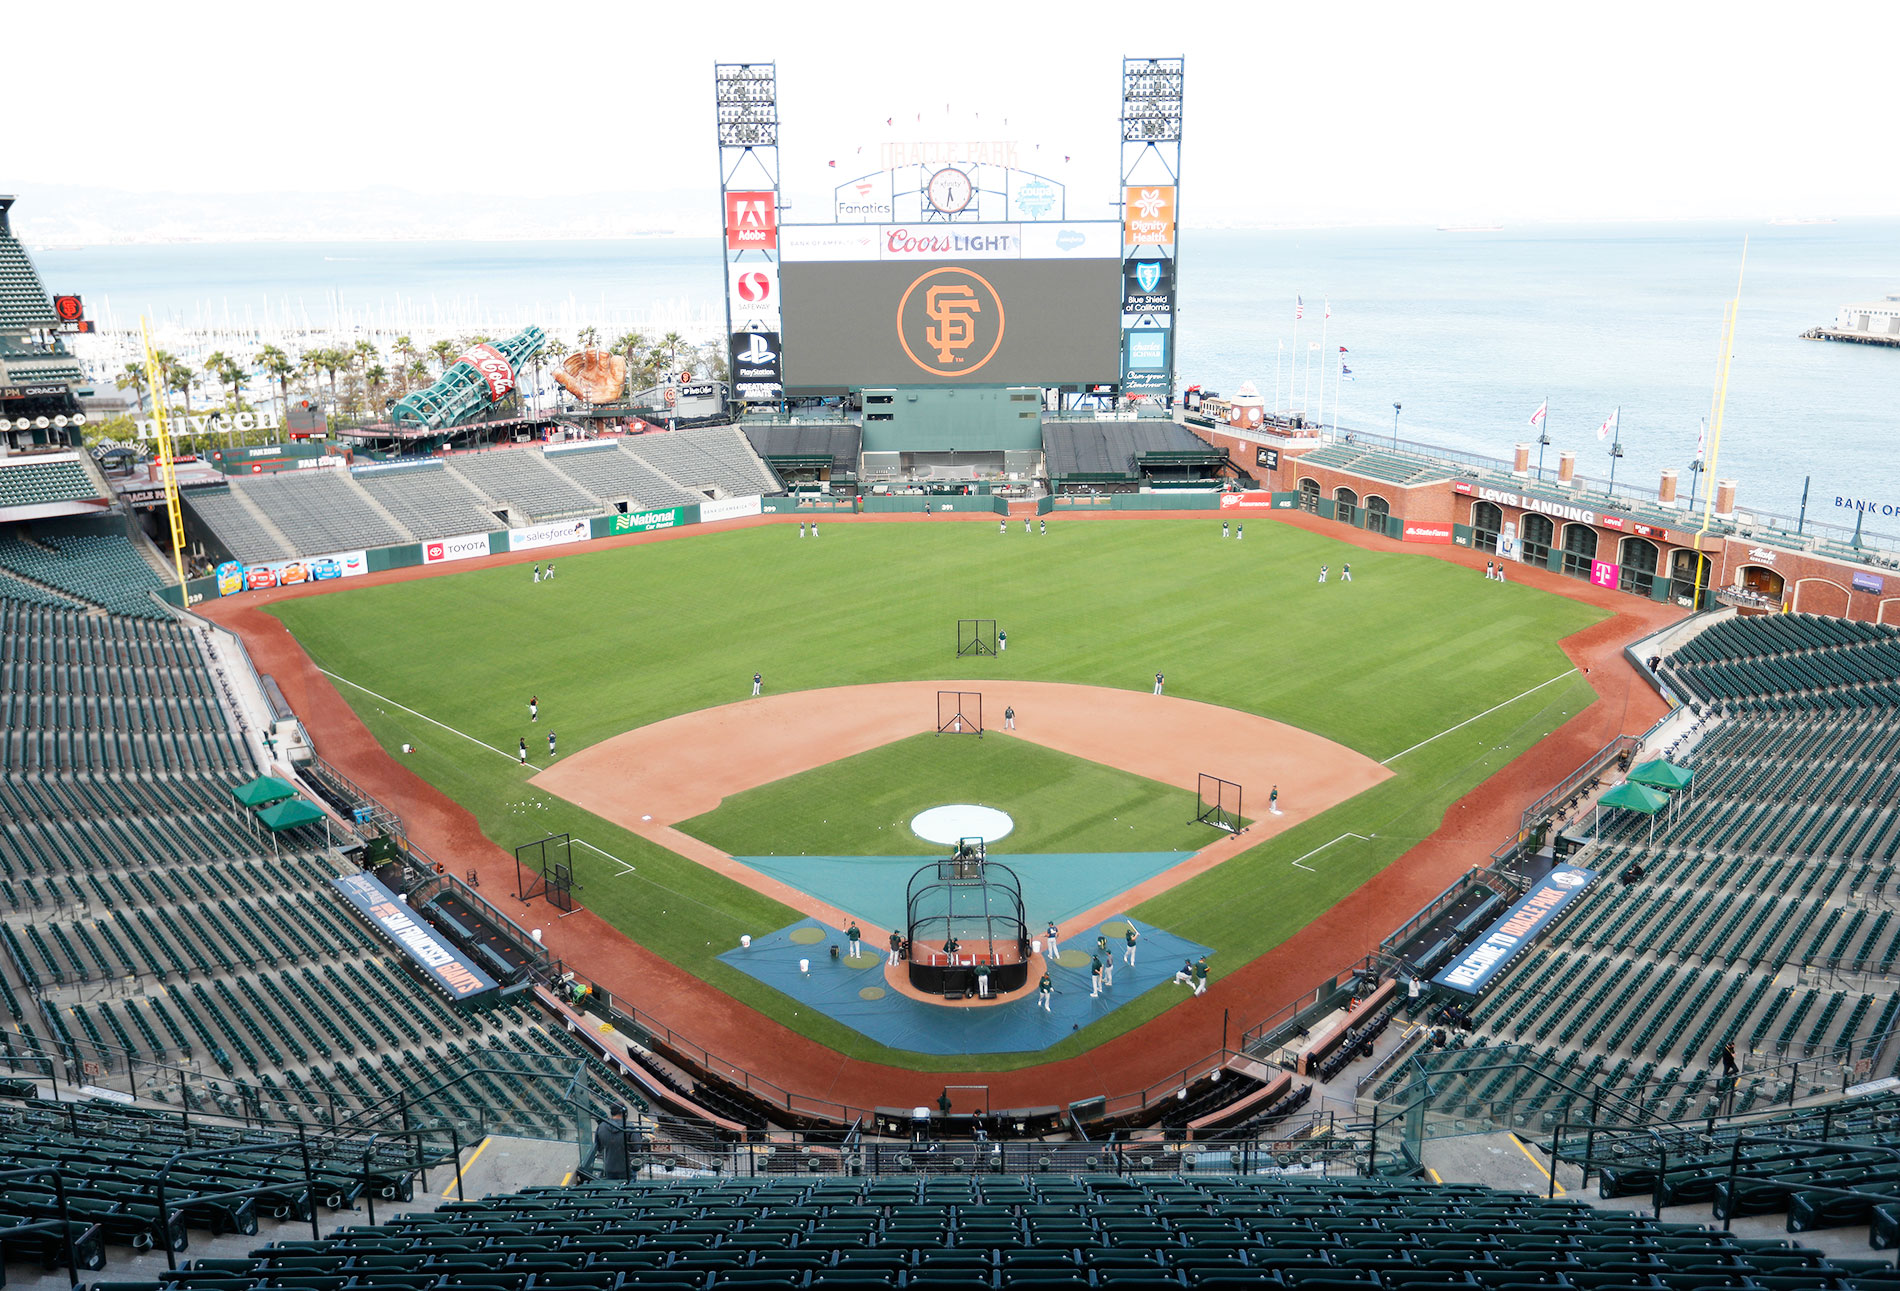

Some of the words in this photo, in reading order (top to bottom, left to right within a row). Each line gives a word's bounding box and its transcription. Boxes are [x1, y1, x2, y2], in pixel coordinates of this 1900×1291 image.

[880, 141, 959, 171] ORACLE
[967, 140, 1019, 170] PARK
[839, 202, 891, 215] Fanatics
[738, 230, 766, 240] Adobe
[1131, 220, 1167, 233] Dignity
[886, 228, 950, 253] Coors
[954, 235, 1010, 251] LIGHT
[1128, 296, 1144, 304] Blue
[1145, 296, 1168, 304] Shield
[1136, 304, 1170, 312] California
[5, 388, 20, 396] PM
[26, 386, 67, 395] ORACLE
[91, 438, 151, 460] Ghirardelli
[1521, 496, 1594, 525] LANDING
[1834, 496, 1878, 513] BANK
[629, 509, 675, 527] National
[656, 521, 674, 529] Rental
[526, 526, 574, 542] salesforce
[447, 541, 487, 553] TOYOTA
[187, 593, 203, 604] 339
[1677, 596, 1693, 607] 309
[1527, 886, 1568, 910] PARK
[380, 912, 415, 932] SAN
[1499, 904, 1548, 937] ORACLE
[395, 925, 455, 967] FRANCISCO
[1487, 932, 1519, 949] TO
[1444, 940, 1508, 987] WELCOME
[435, 961, 484, 994] GIANTS
